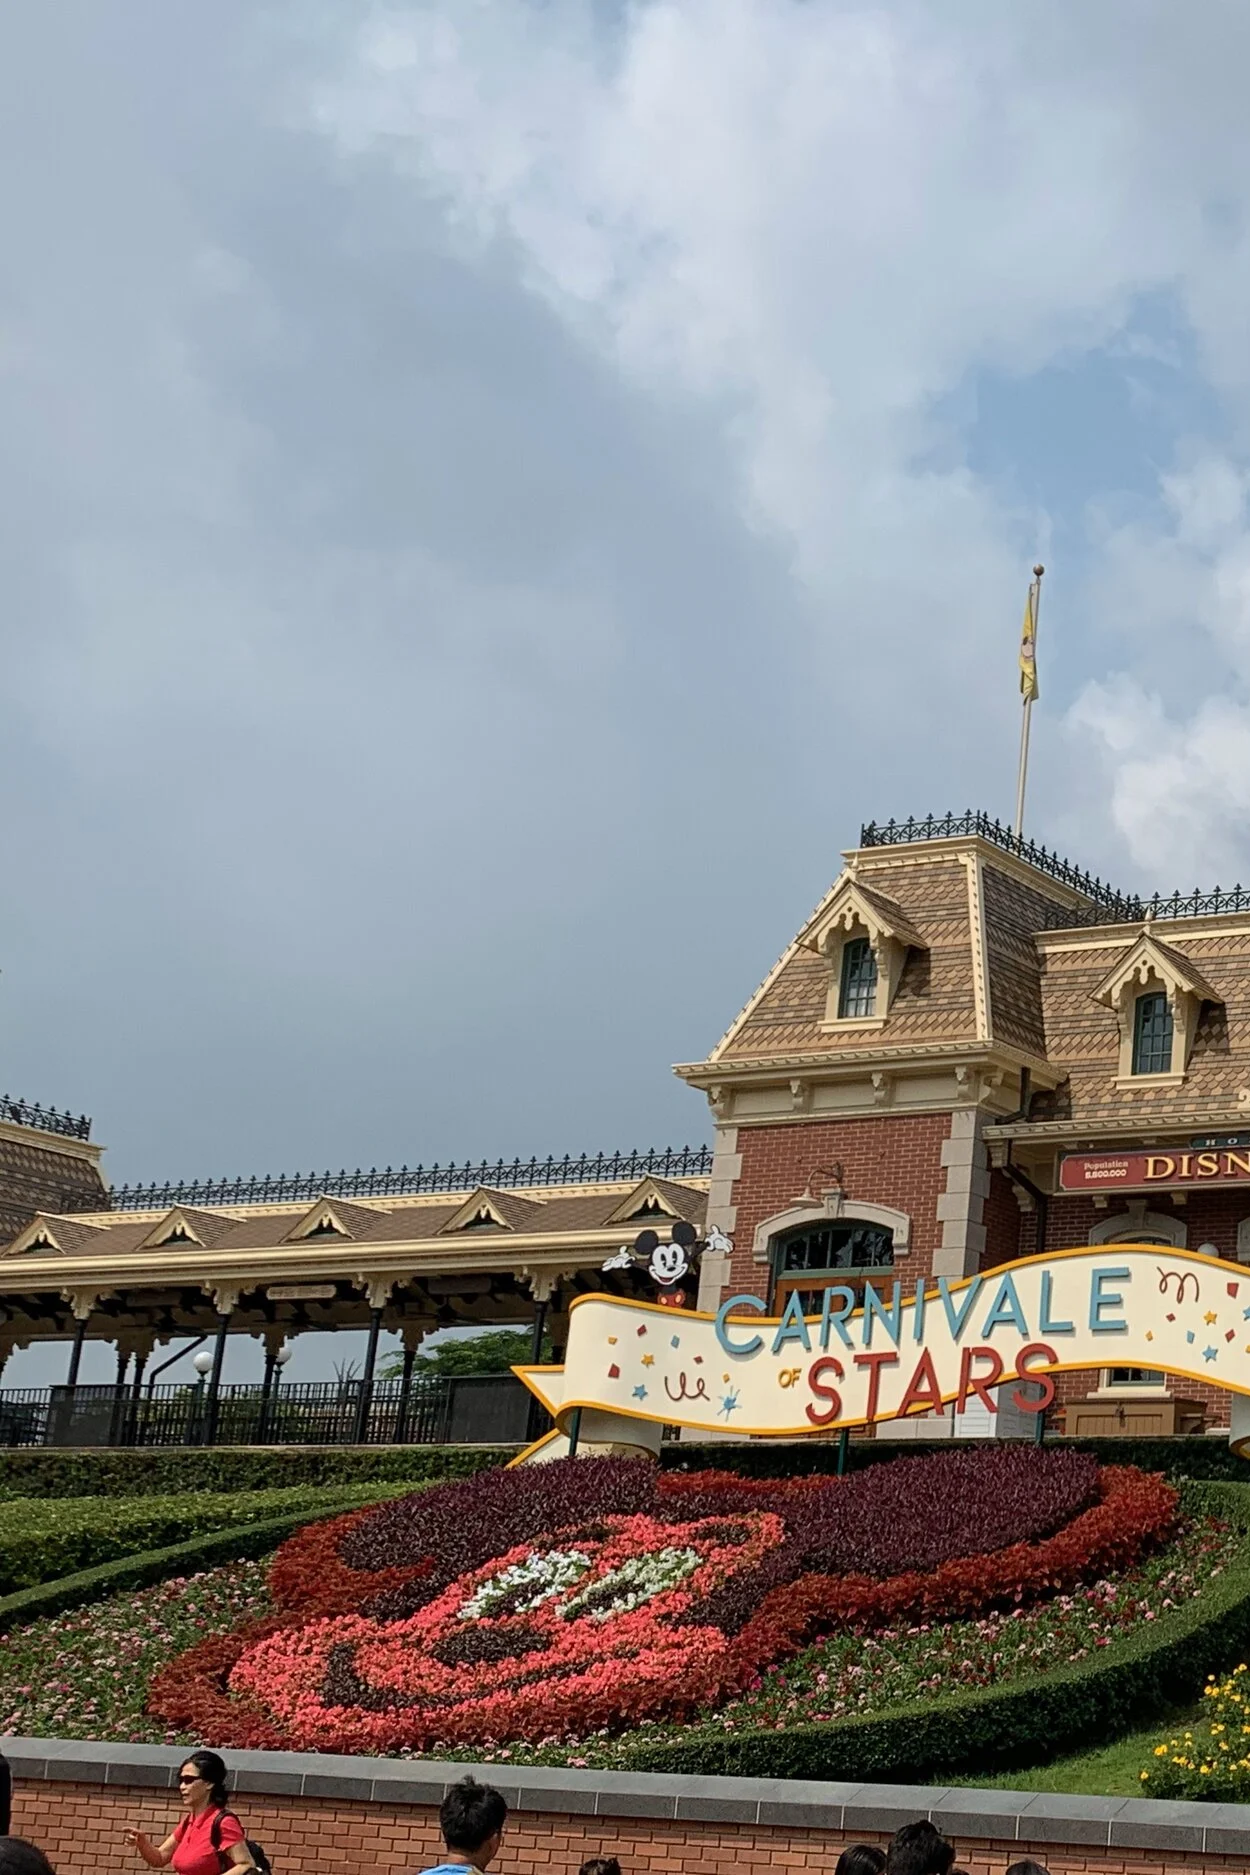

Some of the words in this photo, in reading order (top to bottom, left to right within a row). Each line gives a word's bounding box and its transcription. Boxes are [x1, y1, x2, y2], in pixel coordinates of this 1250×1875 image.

[1083, 1160, 1129, 1170] Population
[714, 1266, 1132, 1355] CARNIVALE
[778, 1367, 802, 1389] OF
[805, 1342, 1060, 1426] STARS
